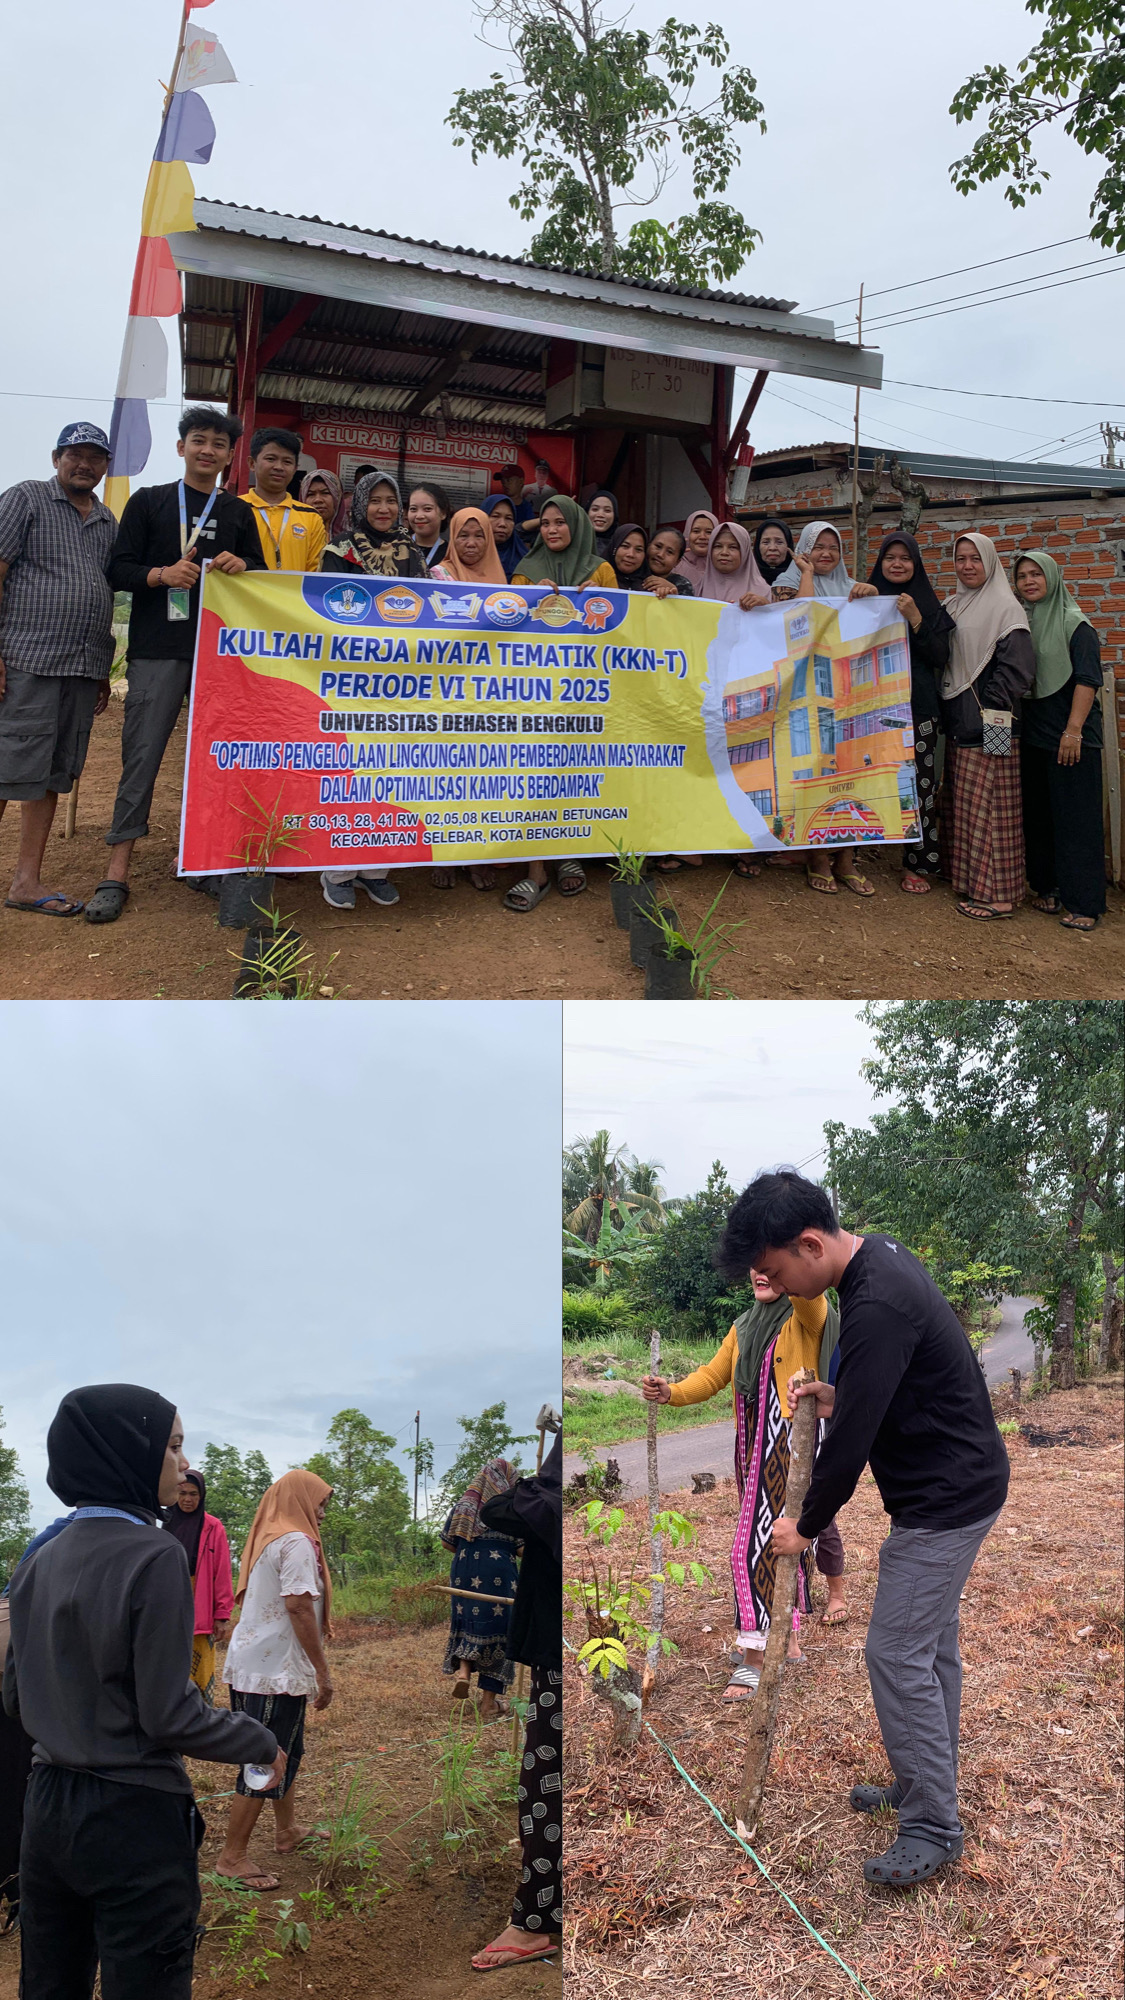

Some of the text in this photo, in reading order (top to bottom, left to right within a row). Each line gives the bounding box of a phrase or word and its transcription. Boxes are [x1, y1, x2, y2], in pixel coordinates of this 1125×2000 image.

[302, 404, 426, 431] POSKAMLING
[450, 421, 471, 438] 30
[473, 423, 502, 441] RW
[503, 427, 528, 444] 05
[311, 425, 517, 464] KELURAHAN BETUNGAN
[218, 628, 687, 678] KULIAH KERJA NYATA TEMATIK (KKN-T)
[320, 672, 610, 702] PERIODE VI TAHUN 2025
[320, 712, 604, 733] UNIVERSITAS DEHASEN BENGKULU
[283, 743, 386, 769] PENGELOLAAN
[389, 744, 477, 768] LINGKUNGAN
[479, 744, 507, 768] DAN
[510, 744, 606, 768] PEMBERDAYAAN
[608, 745, 686, 767] MASYARAKAT
[320, 776, 372, 803] DALAM
[374, 775, 467, 802] OPTIMALISASI
[469, 775, 525, 800] KAMPUS
[283, 815, 304, 829] RT
[354, 814, 375, 829] 28,
[377, 814, 392, 827] 41
[397, 813, 419, 826] RW
[425, 812, 478, 827] 02,05,08
[481, 810, 558, 824] KELURAHAN
[562, 808, 628, 821] BETUNGAN
[331, 826, 591, 847] KECAMATAN SELEBAR, KOTA BENGKULU
